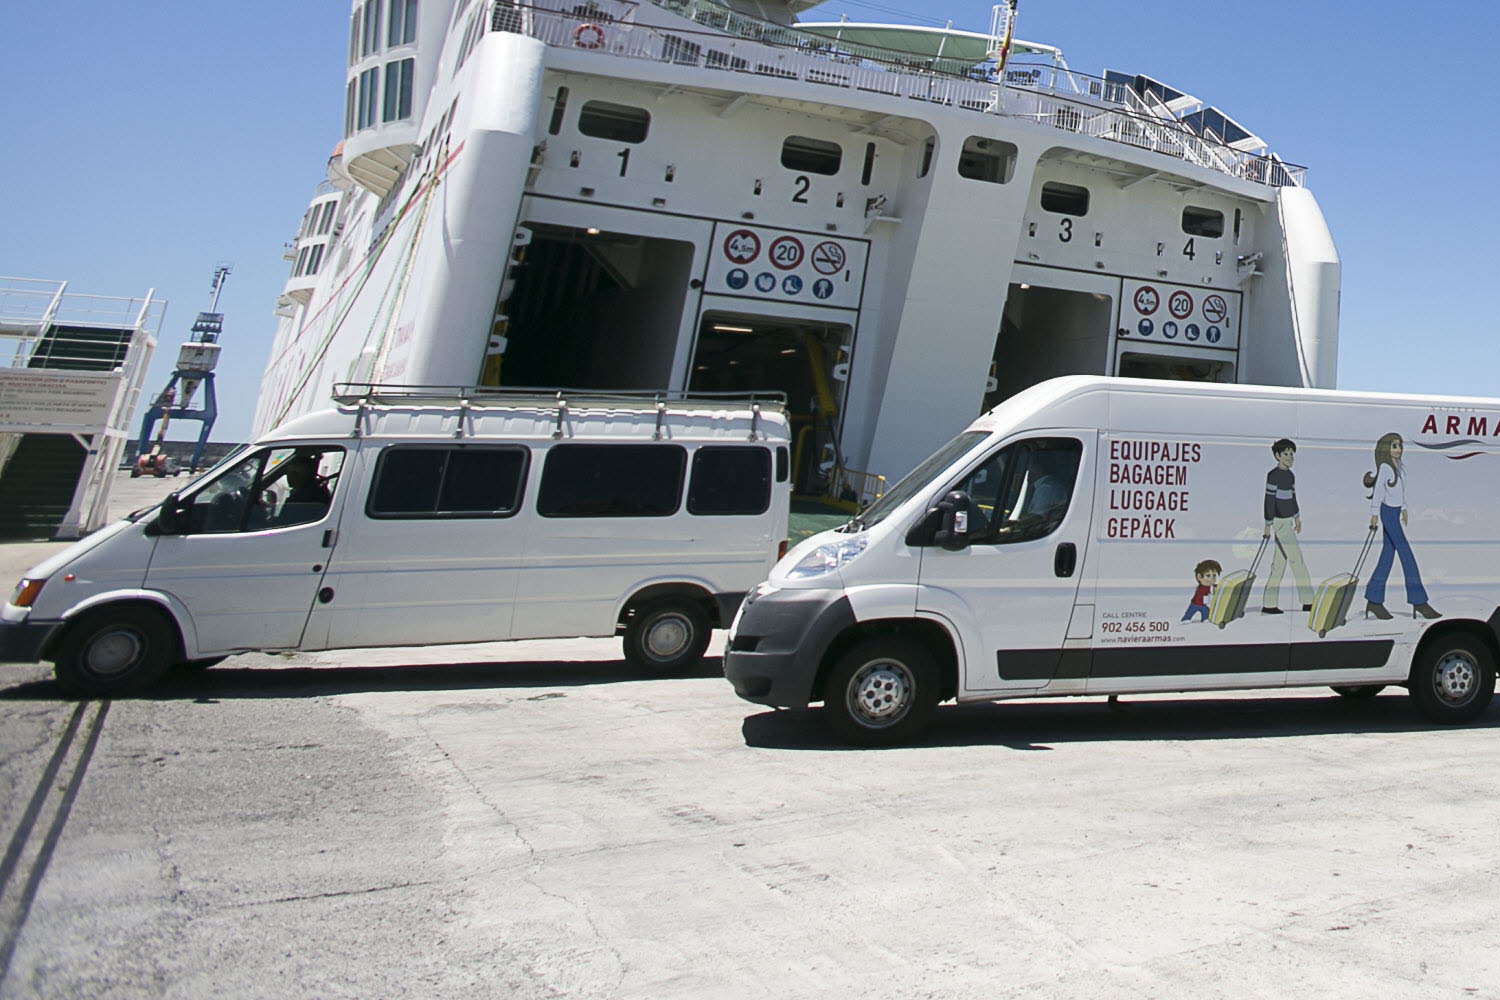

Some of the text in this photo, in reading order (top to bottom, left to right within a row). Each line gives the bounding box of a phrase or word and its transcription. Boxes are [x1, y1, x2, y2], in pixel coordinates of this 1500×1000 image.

[617, 148, 630, 177] 1
[792, 175, 810, 203] 2
[1058, 217, 1073, 243] 3
[776, 244, 798, 262] 20
[1182, 237, 1196, 261] 4
[1174, 297, 1189, 313] 20
[1110, 440, 1202, 463] EQUIPAJES
[1109, 463, 1187, 486] BAGAGEM
[1110, 489, 1189, 511] LUGGAGE
[1107, 514, 1176, 539] GEPÄCK
[1102, 621, 1170, 632] 902 456 500
[1101, 634, 1186, 643] www.navieraarmas.com
